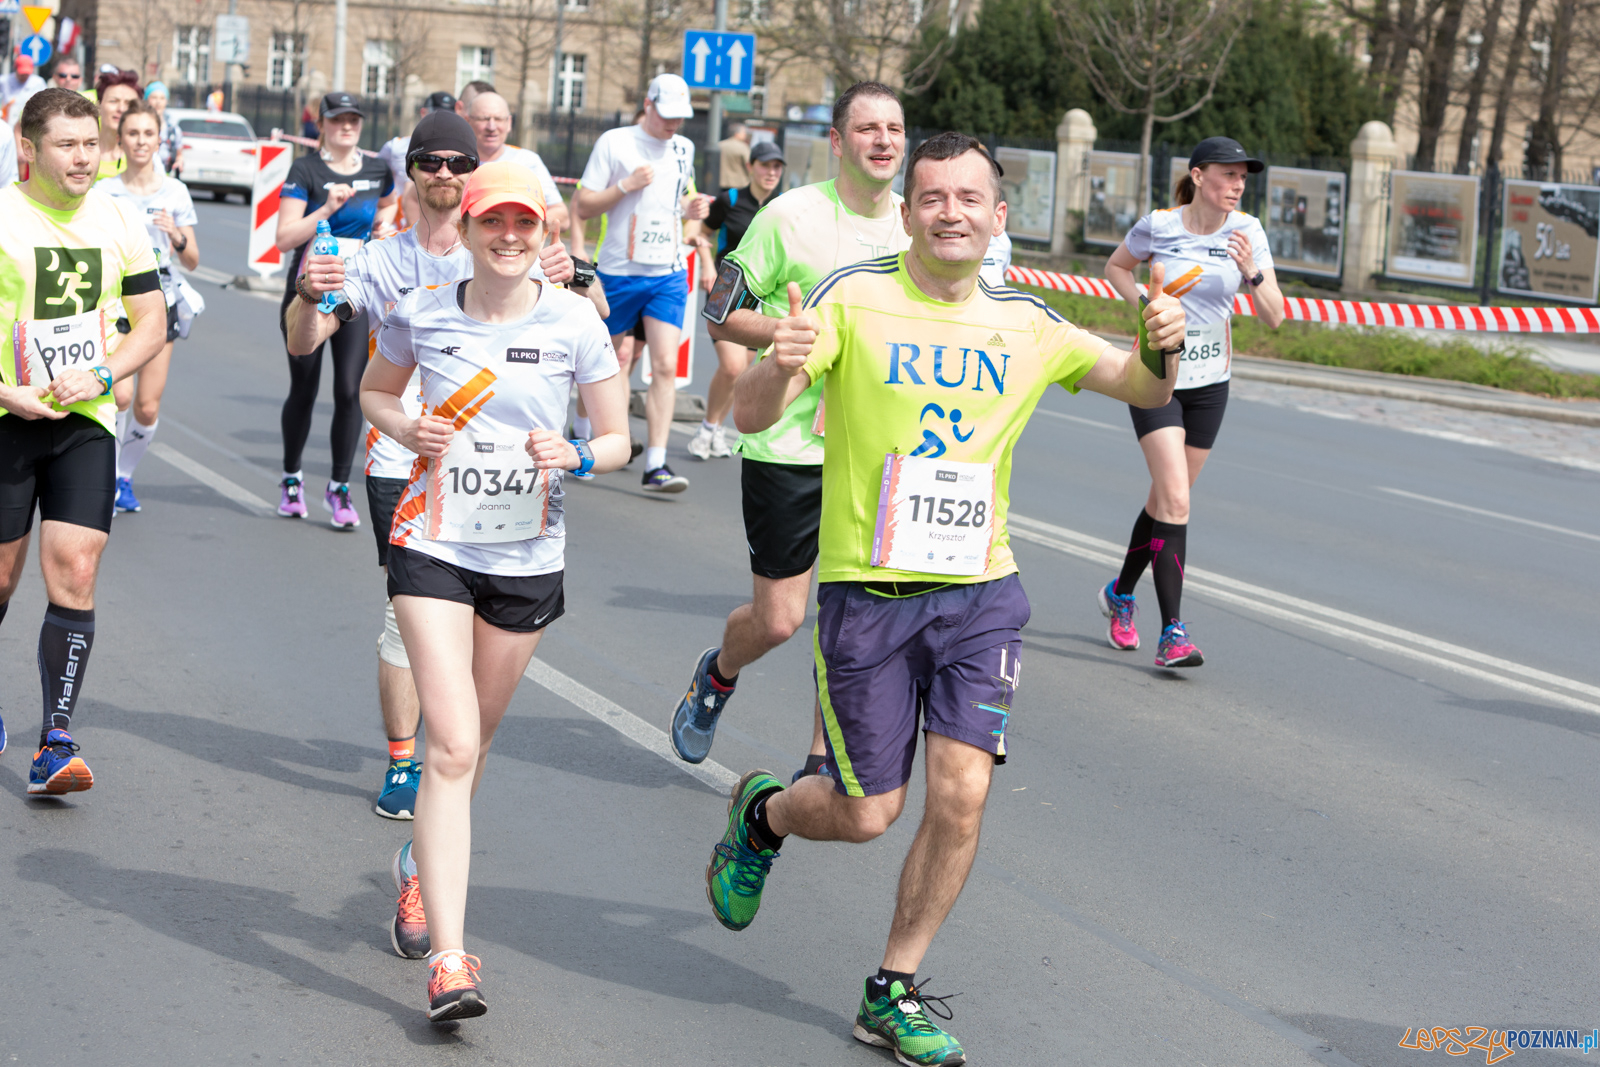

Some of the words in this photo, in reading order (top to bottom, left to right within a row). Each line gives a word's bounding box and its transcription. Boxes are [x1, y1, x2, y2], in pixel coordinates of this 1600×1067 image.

[642, 231, 671, 243] 2764
[41, 340, 95, 367] 9190
[440, 346, 461, 356] 4F
[884, 342, 1010, 395] RUN
[449, 467, 539, 496] 10347
[476, 502, 511, 511] Joanna
[909, 495, 986, 528] 11528
[928, 531, 966, 542] Krzysztof
